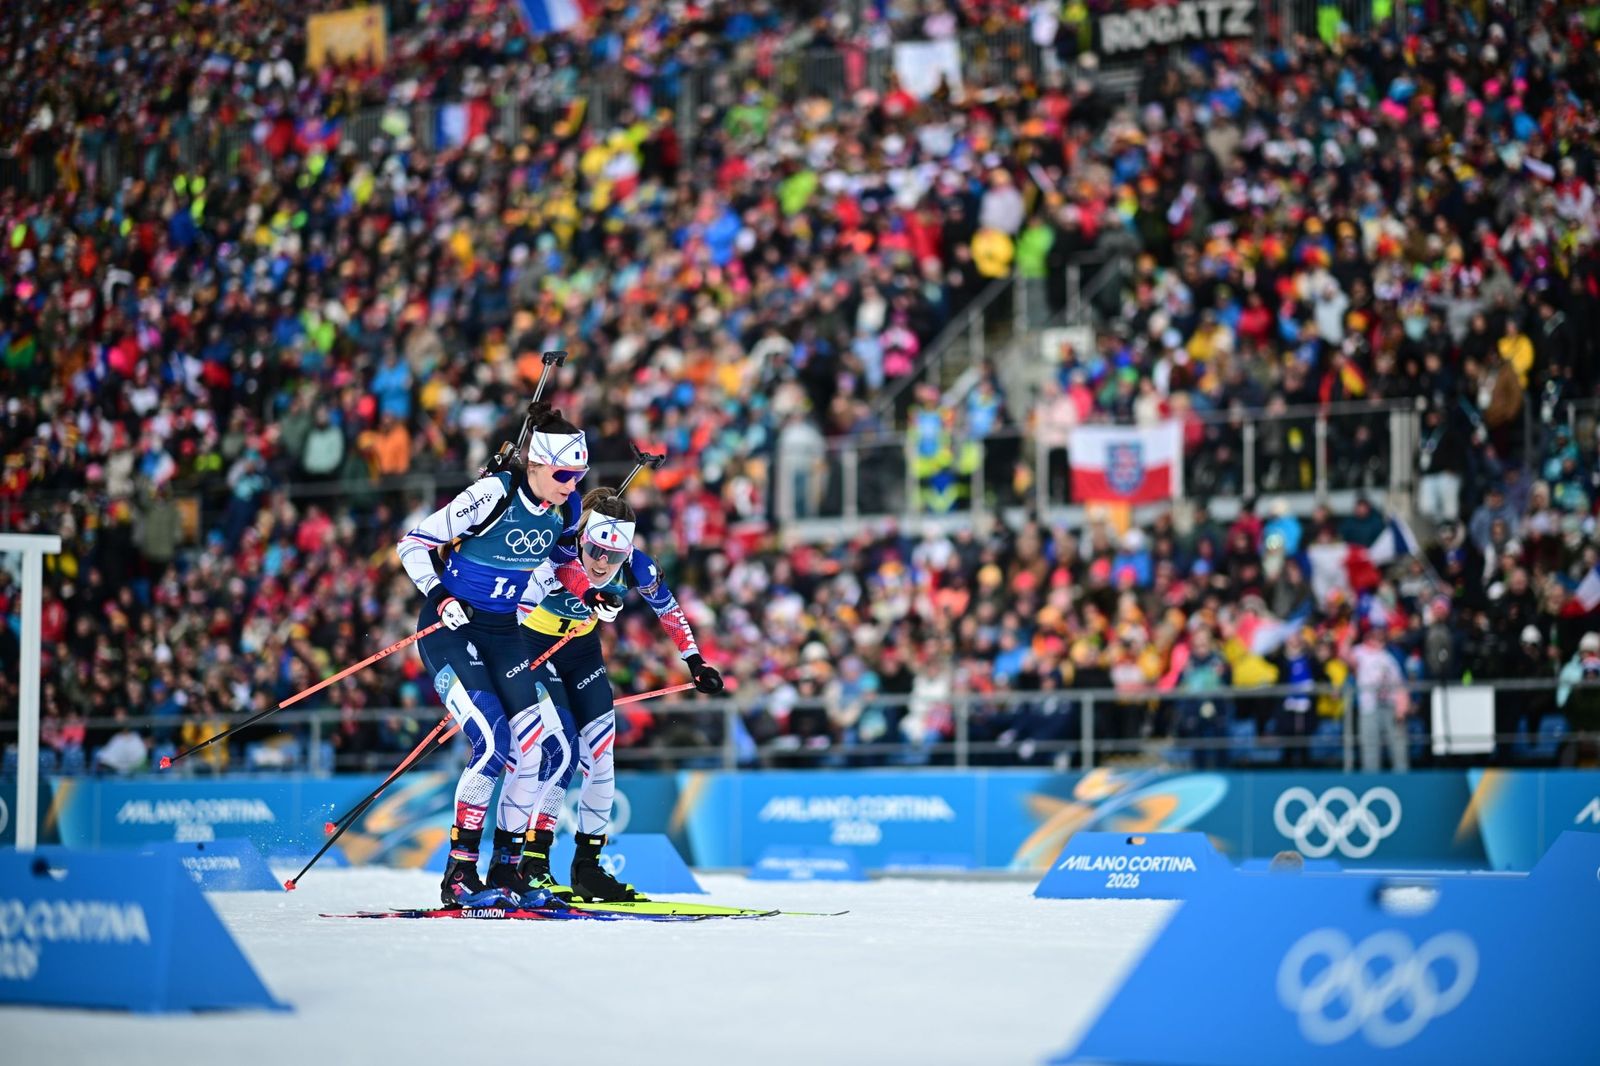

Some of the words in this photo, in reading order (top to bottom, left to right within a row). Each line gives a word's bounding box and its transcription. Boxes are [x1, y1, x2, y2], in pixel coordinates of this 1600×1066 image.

[456, 497, 486, 518] CRAFT
[506, 659, 530, 678] CRAF
[1058, 854, 1127, 872] MILANO
[1128, 856, 1197, 872] CORTINA
[1105, 872, 1140, 889] 2026
[461, 909, 506, 918] SALOMON
